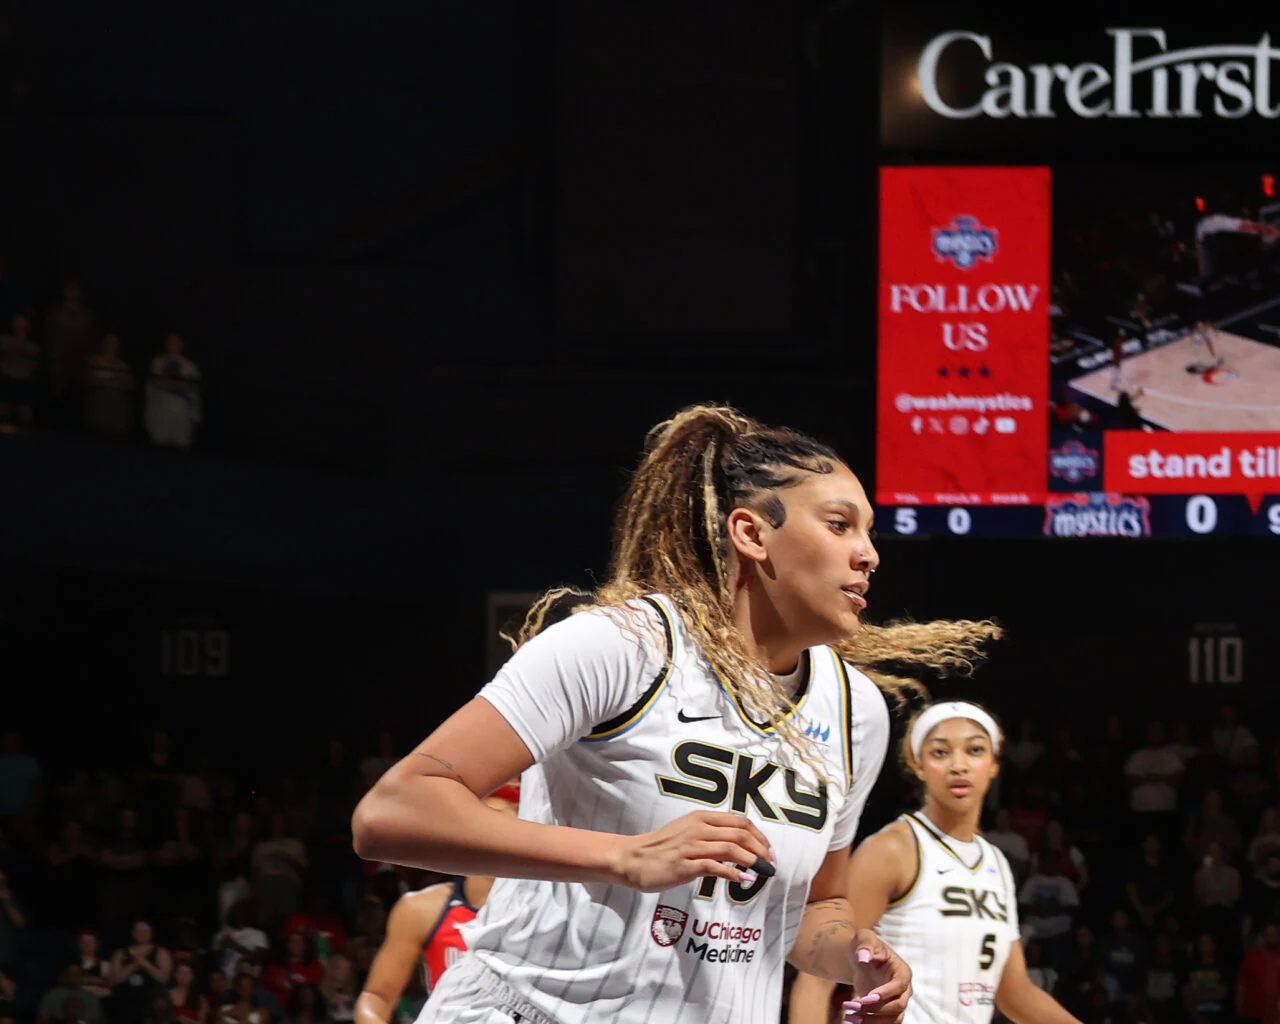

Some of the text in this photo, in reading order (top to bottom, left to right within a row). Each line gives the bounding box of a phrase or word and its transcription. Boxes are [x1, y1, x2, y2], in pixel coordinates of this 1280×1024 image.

[890, 284, 1039, 313] FOLLOW
[942, 321, 990, 350] US
[895, 392, 1033, 412] @washmystics
[1128, 447, 1231, 479] stand
[895, 507, 971, 535] 5 0
[1053, 509, 1142, 536] mystics
[1186, 495, 1218, 534] 0
[160, 629, 230, 677] 109
[1188, 636, 1243, 684] 110
[655, 739, 829, 833] SKY
[692, 918, 762, 944] UChicago
[685, 937, 754, 963] Medicine
[977, 932, 996, 971] 5
